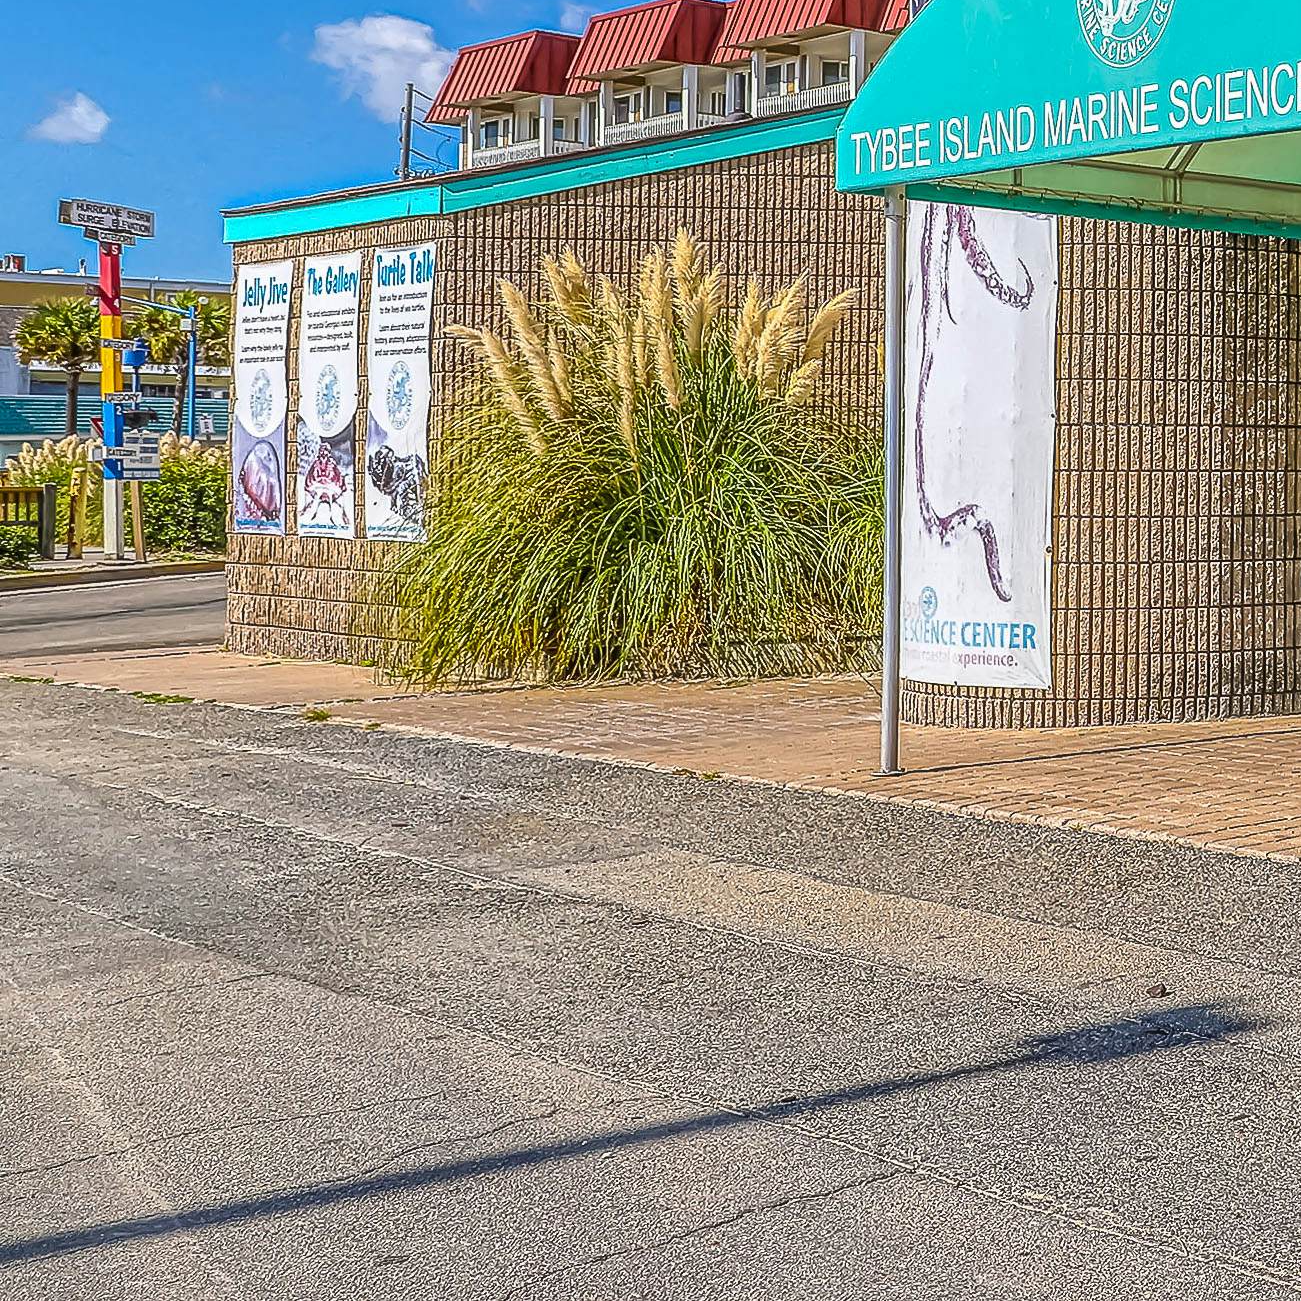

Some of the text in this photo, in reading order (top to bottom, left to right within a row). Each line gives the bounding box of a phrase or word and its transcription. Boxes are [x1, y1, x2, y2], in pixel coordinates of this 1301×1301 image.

[1100, 27, 1152, 61] SCIENCE
[850, 122, 931, 174] TYBEE
[939, 107, 1035, 163] ISLAND
[1044, 83, 1159, 147] MARINE
[307, 266, 358, 297] The Gallery
[376, 249, 434, 287] Turtle Talk
[243, 276, 288, 313] Jelly Jive
[115, 405, 122, 415] 2
[961, 621, 1037, 649] CENTER
